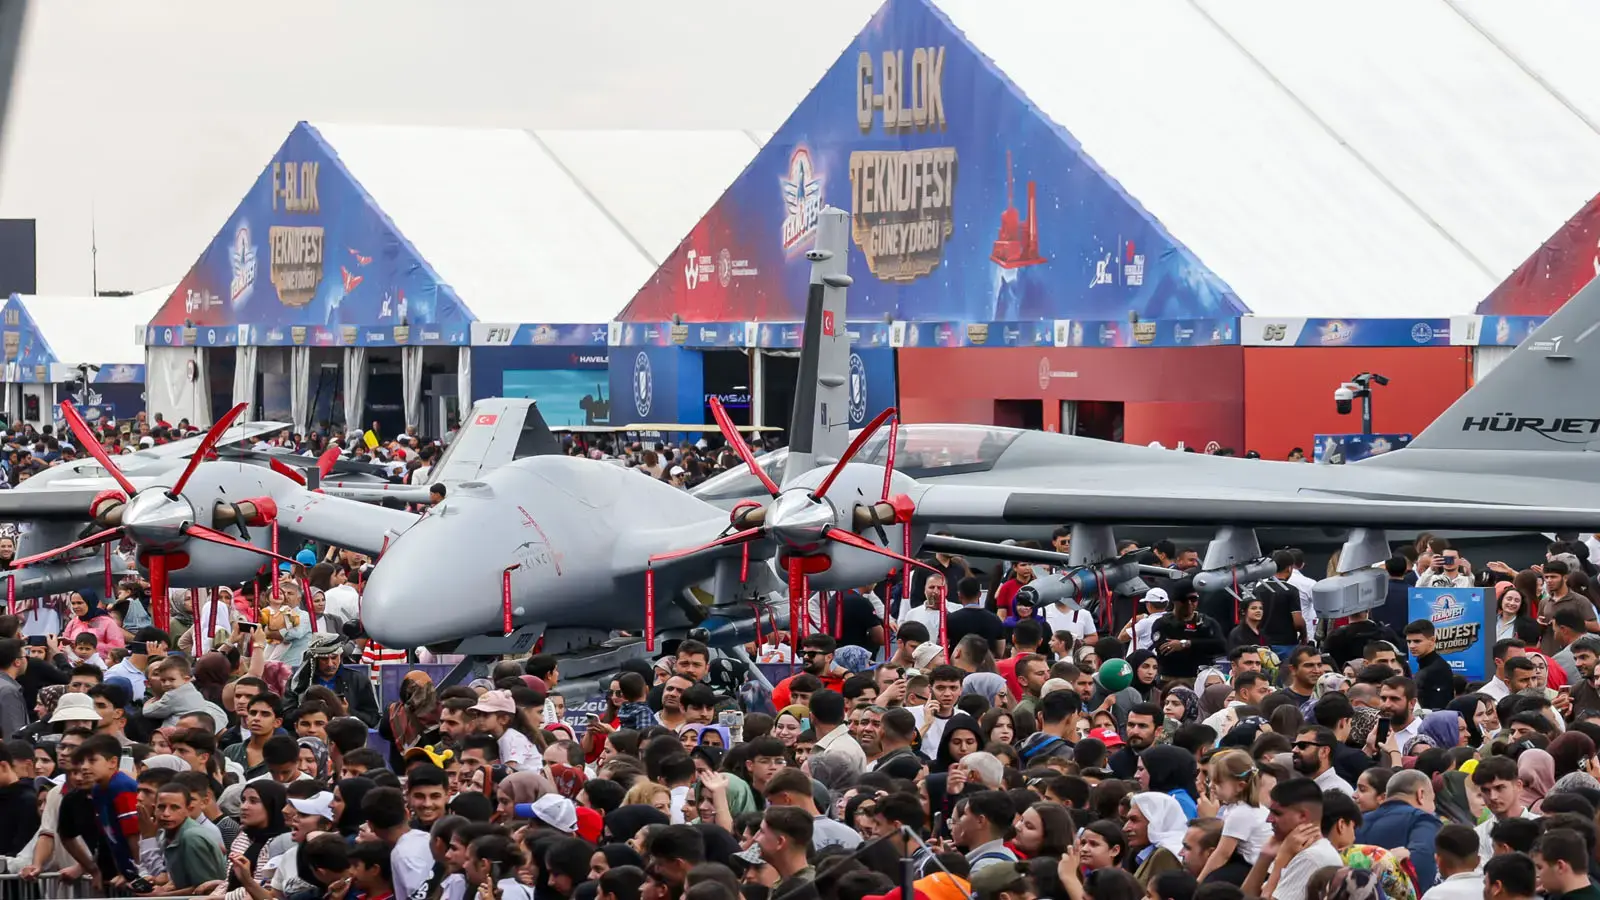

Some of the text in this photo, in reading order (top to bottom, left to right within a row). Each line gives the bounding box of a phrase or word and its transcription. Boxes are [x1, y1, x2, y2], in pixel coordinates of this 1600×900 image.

[857, 46, 946, 130] G-BLOK
[273, 161, 319, 211] F-BLOK
[851, 153, 954, 214] TEKNOFEST
[271, 231, 323, 264] TEKNOFEST
[871, 217, 940, 256] GÜNEYDOĞU
[486, 328, 511, 343] F11
[1262, 324, 1287, 341] G5
[1462, 412, 1600, 443] HÜRJET
[1435, 622, 1478, 640] NOFEST
[568, 699, 608, 712] ZGÜ
